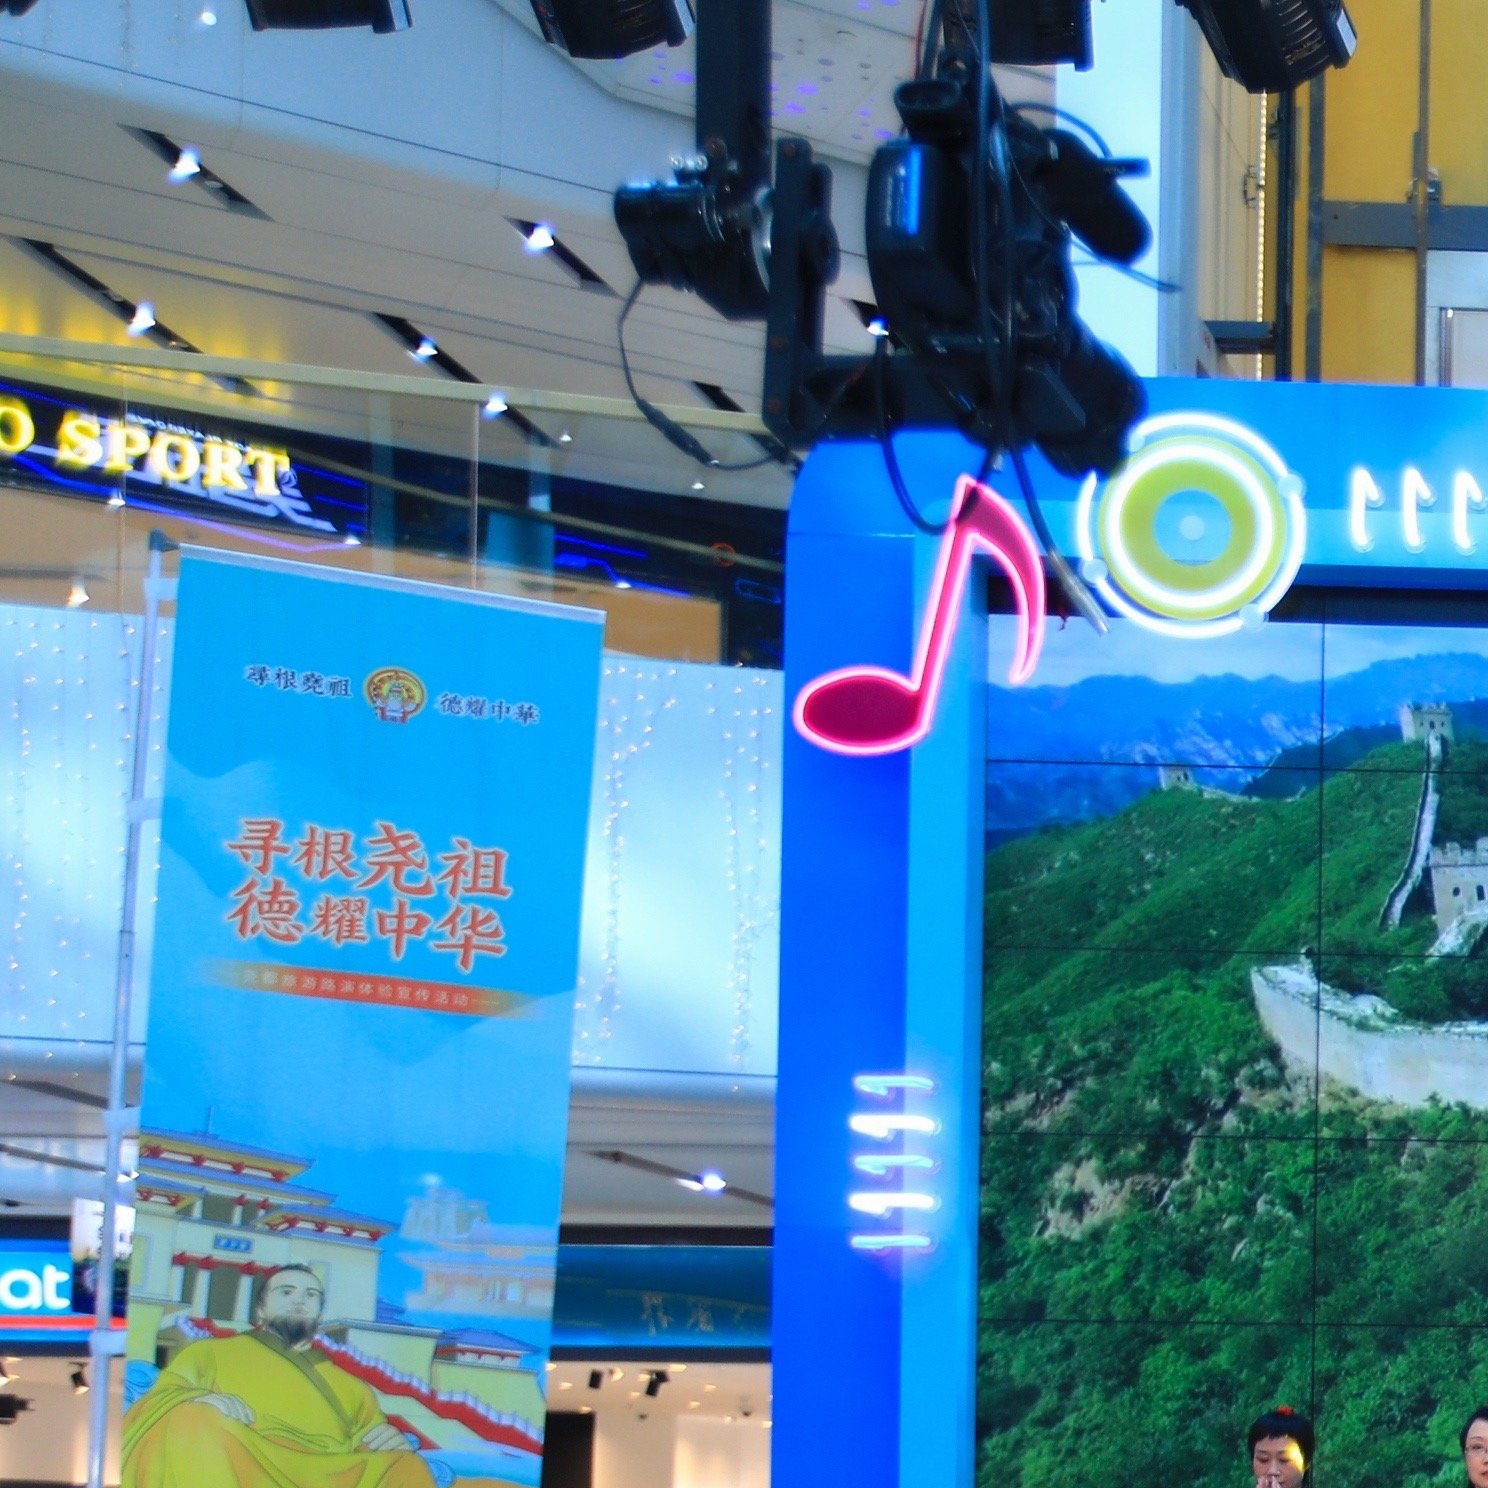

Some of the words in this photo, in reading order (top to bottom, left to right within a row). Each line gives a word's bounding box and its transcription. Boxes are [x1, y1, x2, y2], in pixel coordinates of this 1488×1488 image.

[56, 410, 291, 498] SPORT
[224, 816, 514, 900] 寻根尧祖
[224, 876, 508, 975] 德耀中华
[0, 1264, 71, 1310] at
